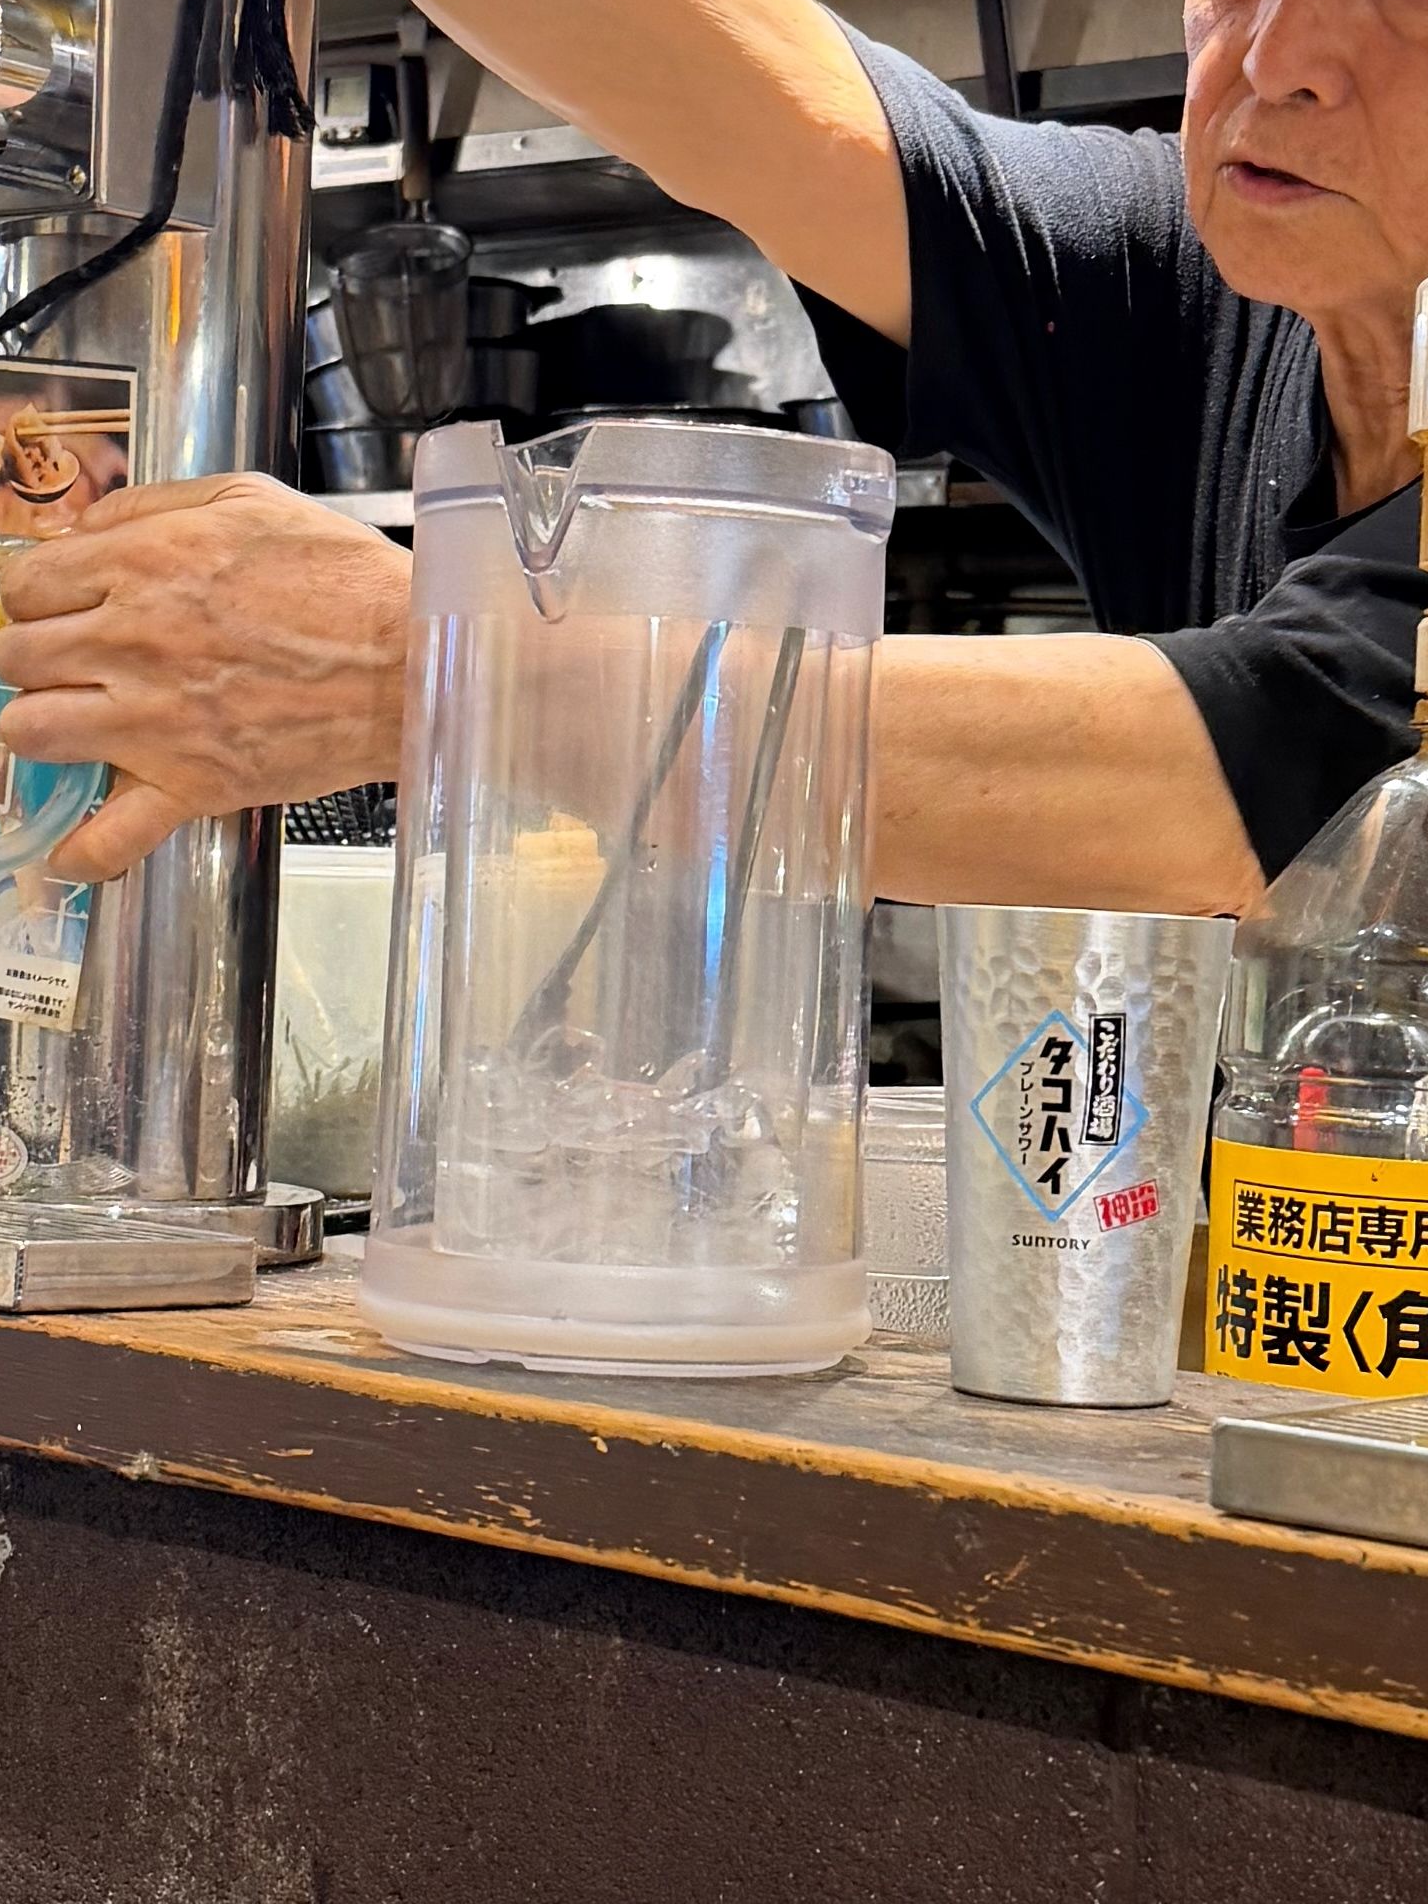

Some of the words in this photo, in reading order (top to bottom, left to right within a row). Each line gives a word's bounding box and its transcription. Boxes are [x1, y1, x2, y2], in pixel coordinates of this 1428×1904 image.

[1018, 1061, 1034, 1165] プレーンサワー
[1037, 1036, 1074, 1195] タコハイ
[1087, 1020, 1119, 1139] こだわり酒場
[1012, 1234, 1091, 1251] SUNTORY
